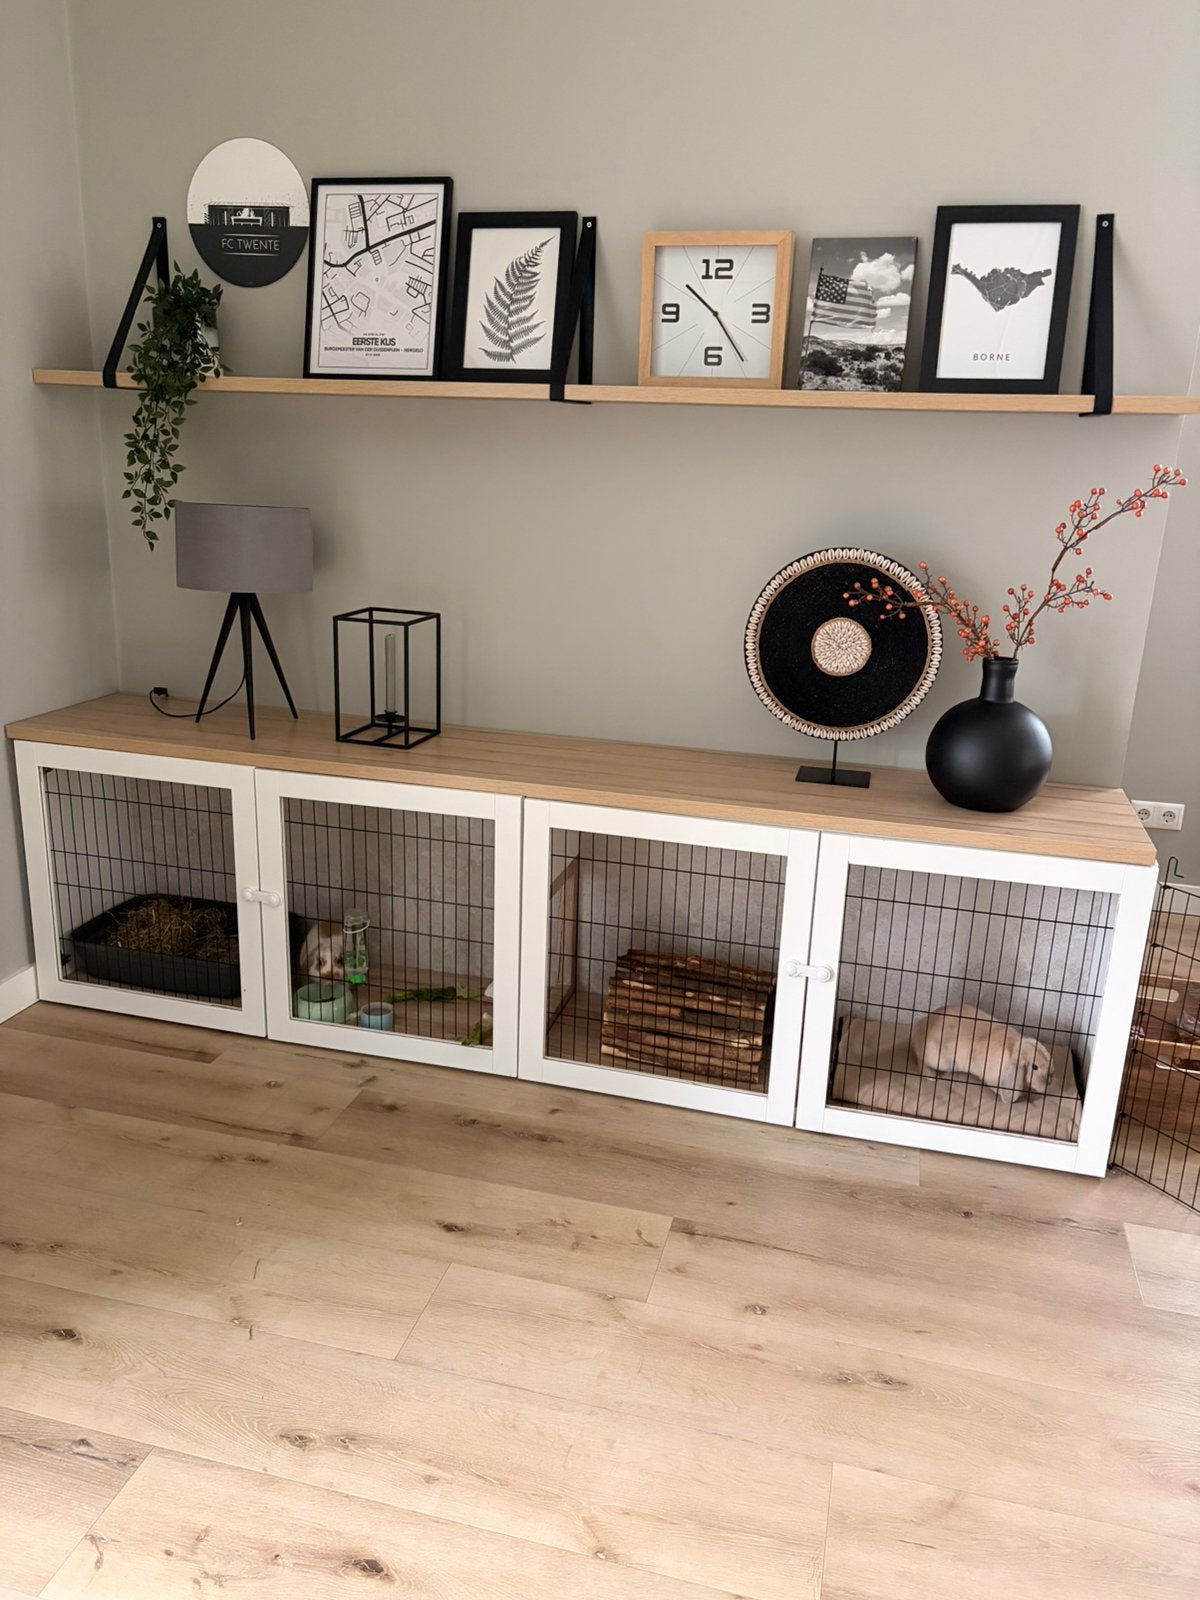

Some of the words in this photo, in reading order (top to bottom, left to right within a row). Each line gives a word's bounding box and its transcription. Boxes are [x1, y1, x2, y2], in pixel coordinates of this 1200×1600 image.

[221, 238, 234, 249] FC
[237, 239, 280, 251] TWENTE
[701, 258, 734, 280] 12
[661, 303, 680, 323] 9
[751, 303, 771, 324] 3
[352, 337, 379, 346] EERSTE
[380, 337, 396, 346] KUS
[703, 346, 723, 366] 6
[972, 352, 1011, 361] BORNE
